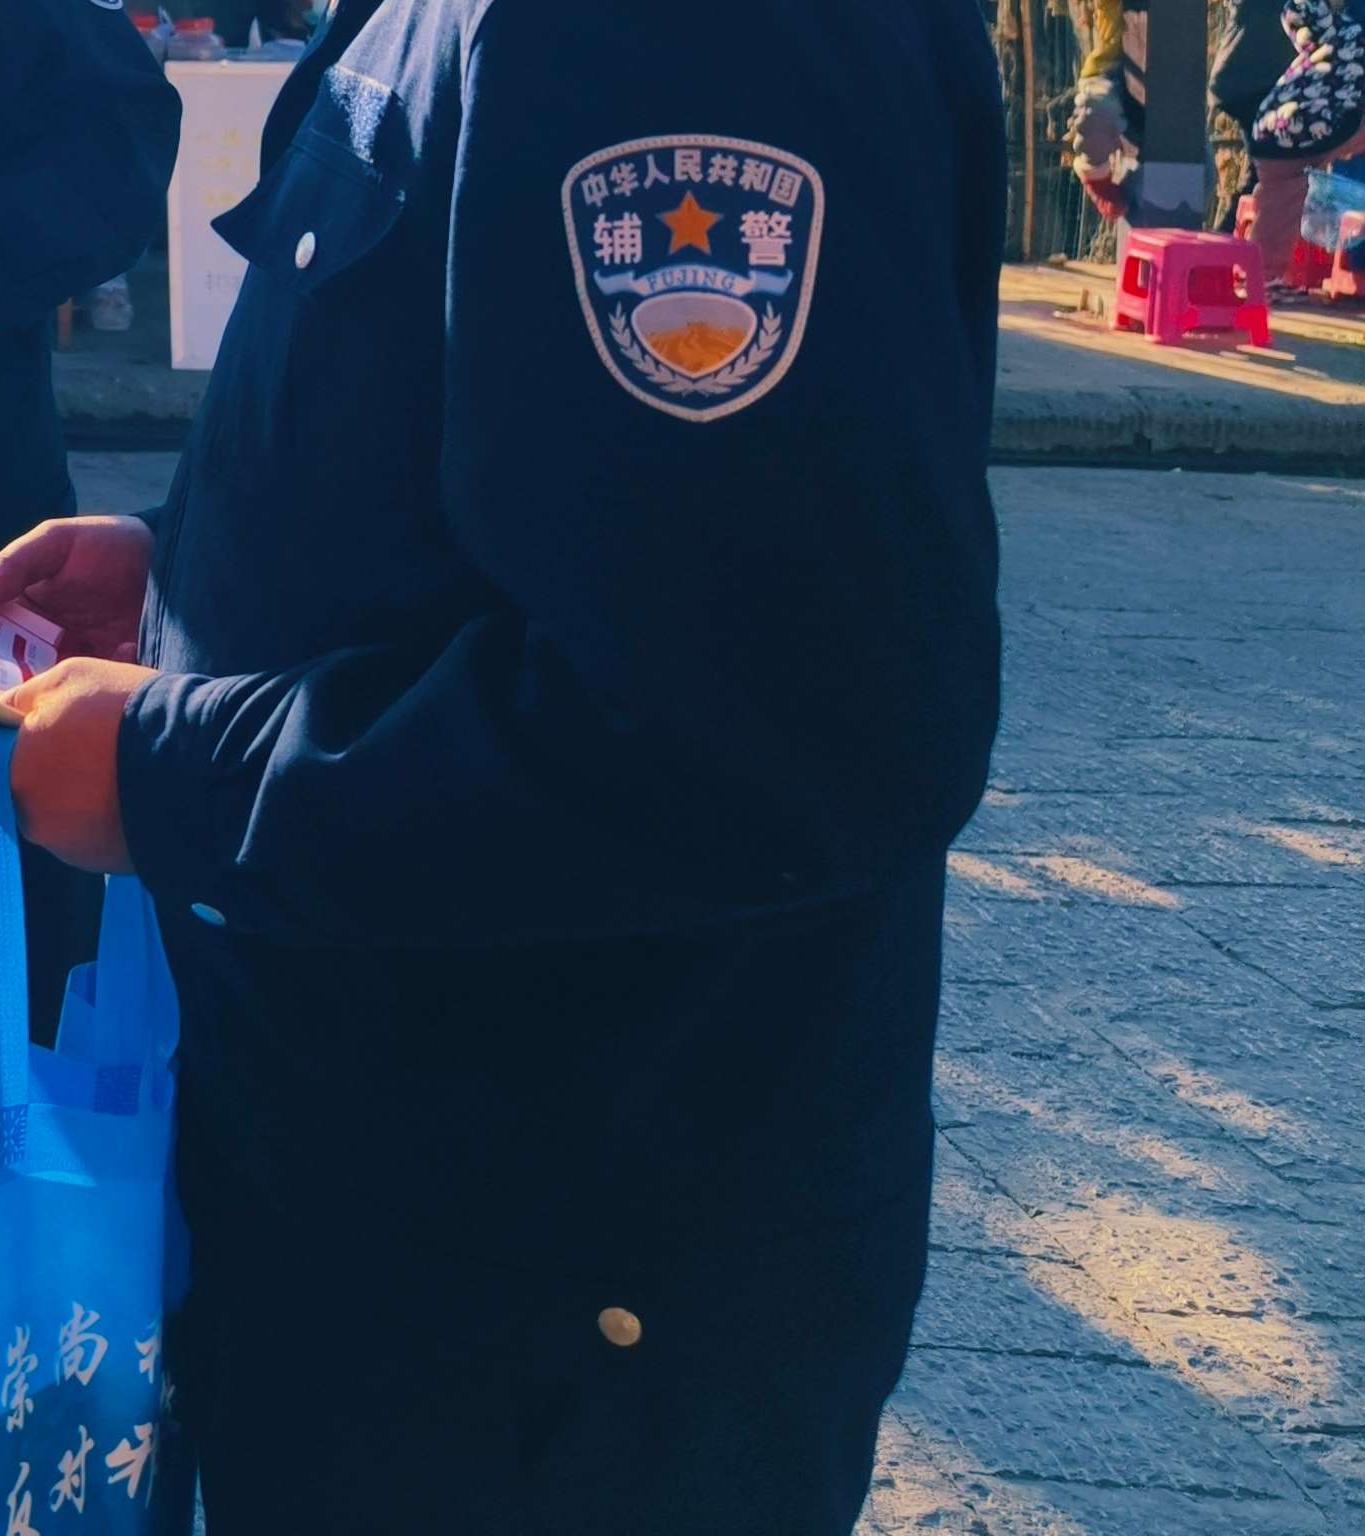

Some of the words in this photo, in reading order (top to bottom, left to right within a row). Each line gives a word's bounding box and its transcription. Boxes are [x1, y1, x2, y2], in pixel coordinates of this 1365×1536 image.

[581, 148, 803, 207] 中华人民共和国
[593, 211, 643, 265] 辅
[739, 210, 793, 266] 警
[646, 268, 736, 293] FUJING
